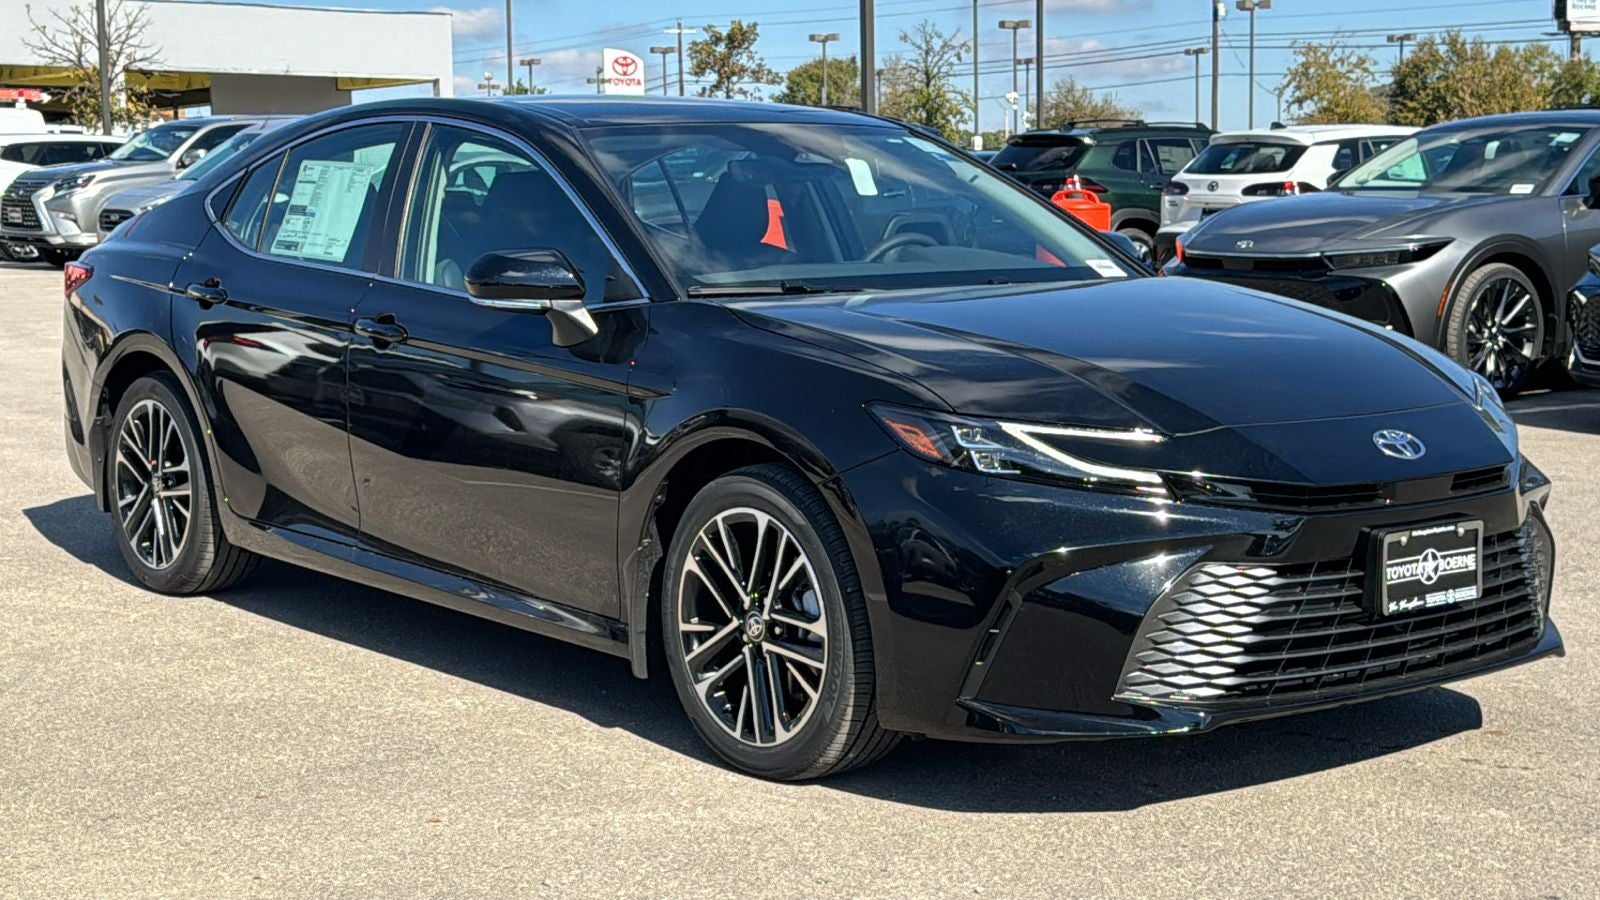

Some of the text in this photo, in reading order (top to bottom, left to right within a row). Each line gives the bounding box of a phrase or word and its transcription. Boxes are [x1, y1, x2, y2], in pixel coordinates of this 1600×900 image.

[608, 78, 642, 86] TOYOTA
[1386, 553, 1476, 580] TOYOTA BOERNE
